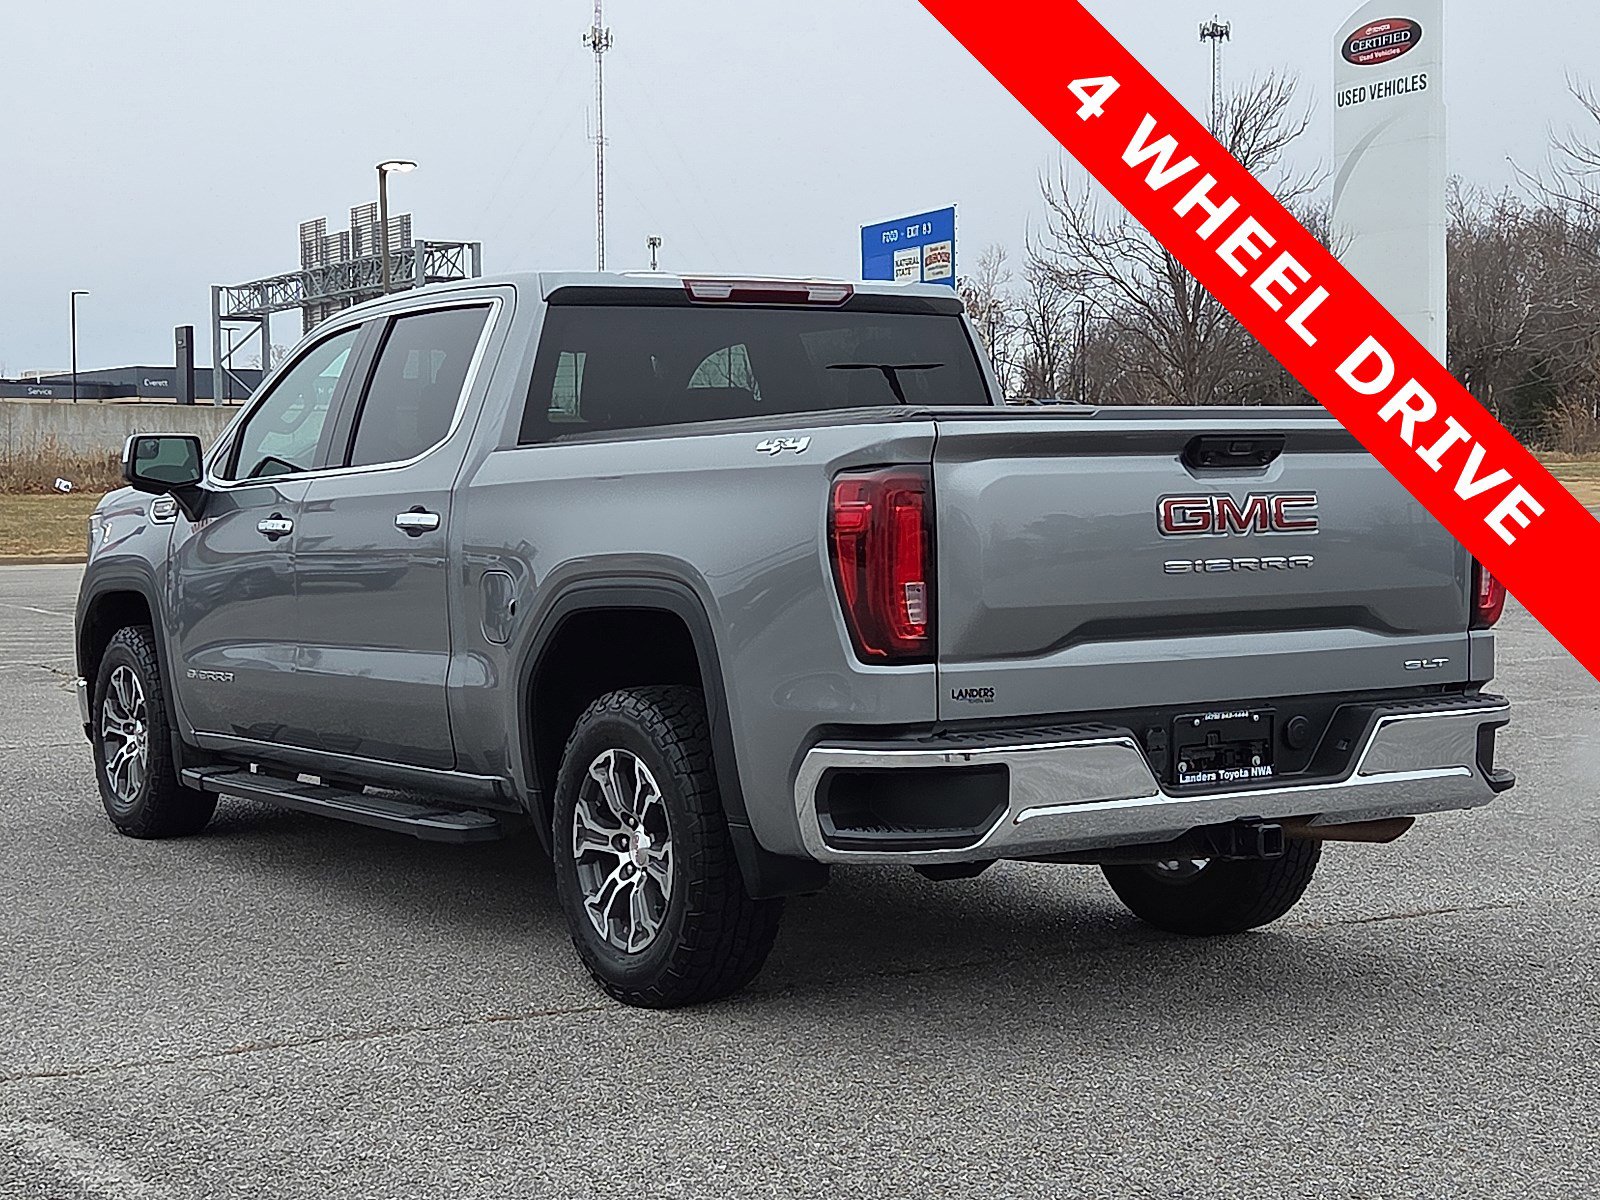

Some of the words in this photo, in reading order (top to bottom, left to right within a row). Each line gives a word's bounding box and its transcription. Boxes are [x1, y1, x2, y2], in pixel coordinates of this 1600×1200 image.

[1350, 30, 1411, 53] CERTIFIED
[1337, 86, 1366, 107] USED
[1369, 73, 1427, 100] VEHICLES
[27, 386, 53, 396] Service
[1157, 491, 1319, 537] GMC
[1162, 554, 1315, 574] SIERRA
[1404, 657, 1450, 670] SLT
[186, 668, 235, 682] SIERRA
[951, 687, 995, 701] LANDERS
[1179, 771, 1216, 784] Landers
[1218, 769, 1249, 783] Toyota
[1251, 765, 1273, 777] NWA
